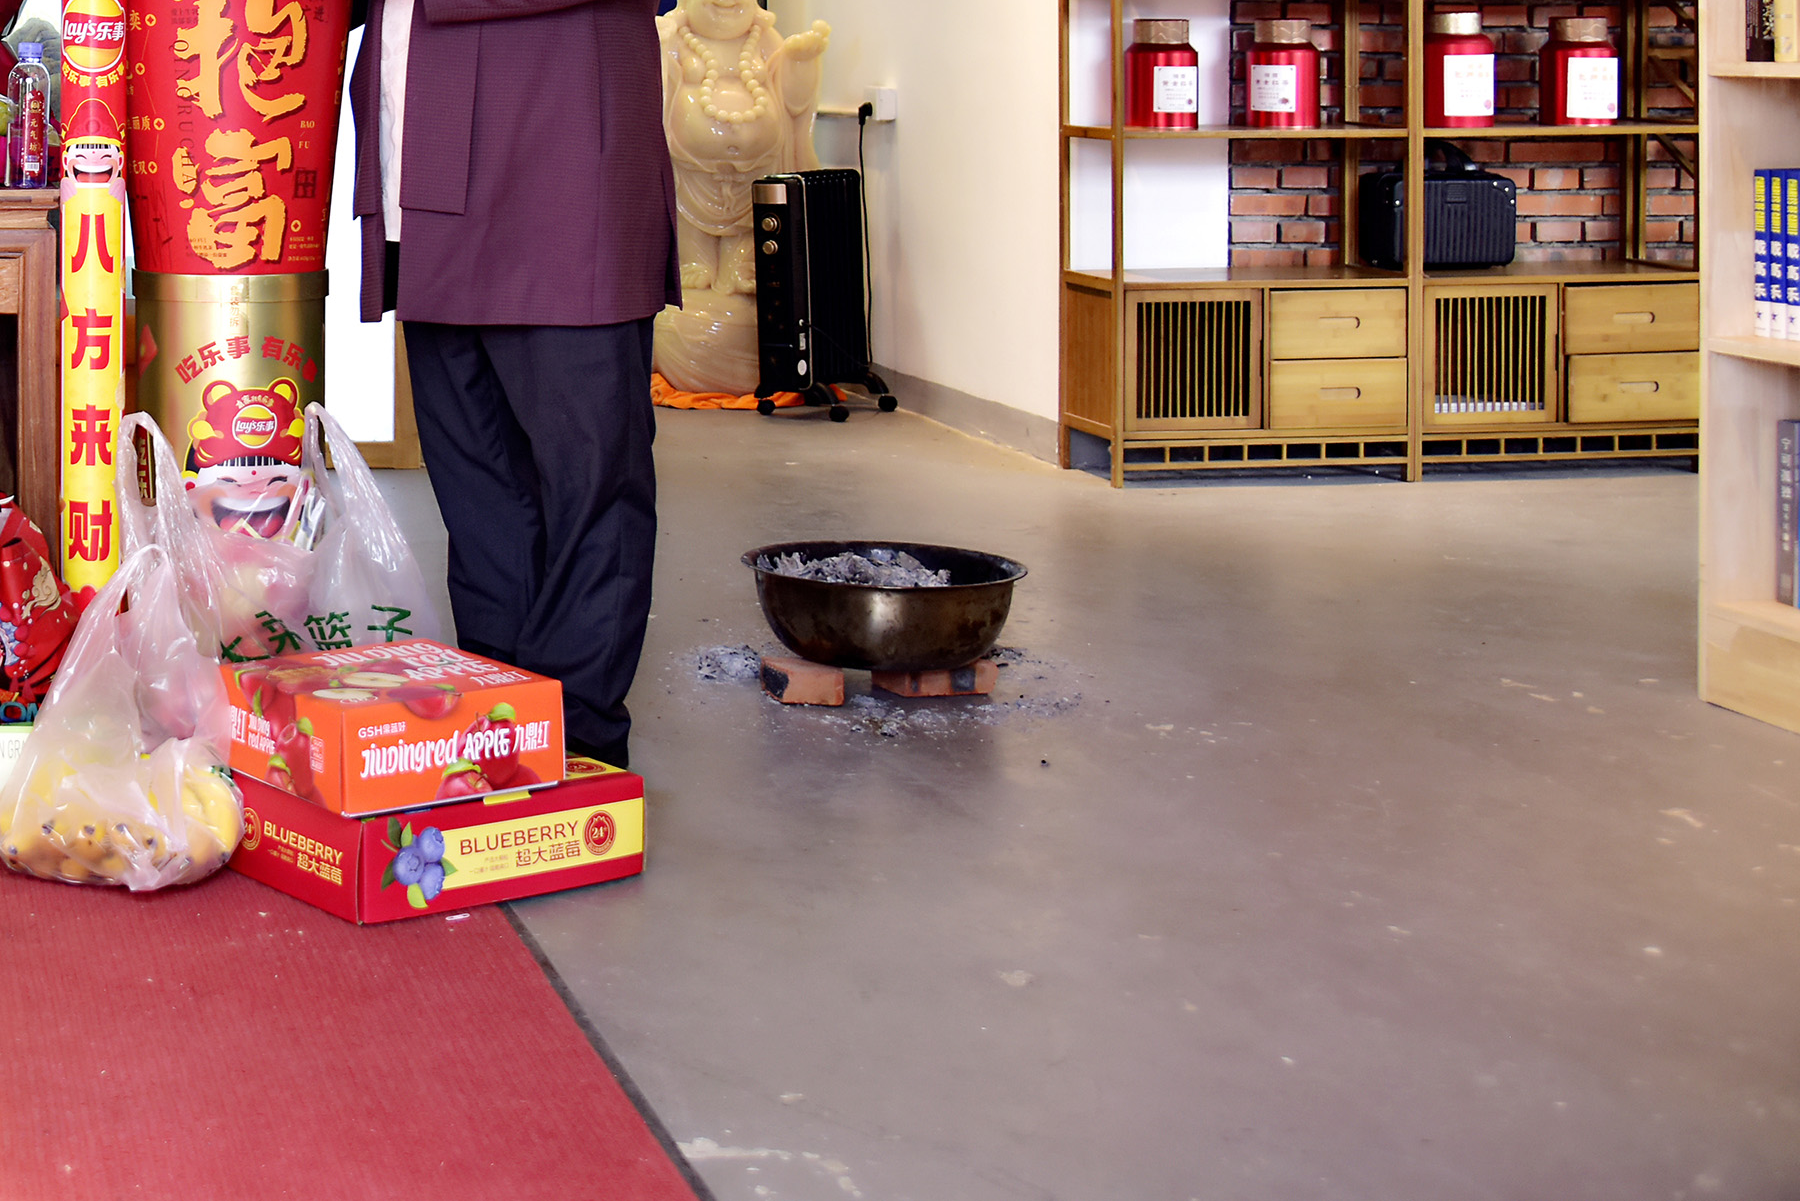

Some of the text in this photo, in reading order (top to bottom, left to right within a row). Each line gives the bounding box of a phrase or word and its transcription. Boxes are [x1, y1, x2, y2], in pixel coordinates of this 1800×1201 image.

[126, 115, 151, 132] 丽质
[300, 120, 315, 129] BAO
[298, 141, 310, 149] FU
[174, 334, 318, 385] 吃乐事 有乐事
[68, 213, 114, 562] 八方来财
[512, 720, 550, 753] 九鼎红
[263, 819, 343, 865] BLUEBERRY
[460, 820, 579, 855] BLUEBERRY
[516, 839, 581, 868] 超大蓝莓
[297, 852, 343, 886] 超大蓝莓
